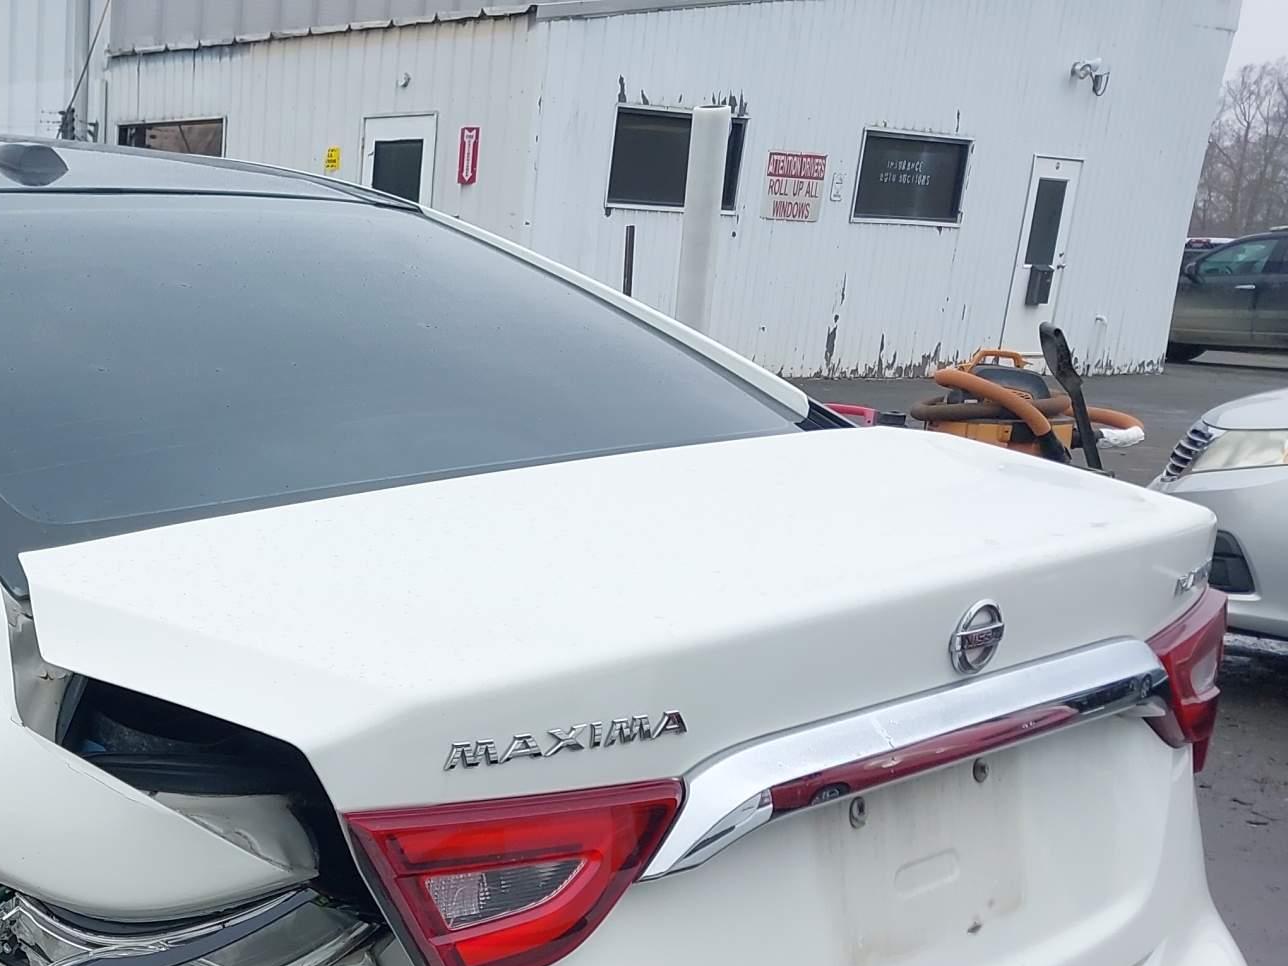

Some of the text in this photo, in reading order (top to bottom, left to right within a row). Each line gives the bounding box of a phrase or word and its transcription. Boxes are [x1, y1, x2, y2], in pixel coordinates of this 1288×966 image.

[768, 154, 825, 178] ATTENTION DRIVERS
[768, 179, 818, 198] ROLL UP ALL
[772, 200, 810, 219] WINDOWS
[443, 709, 688, 771] MAXIMA
